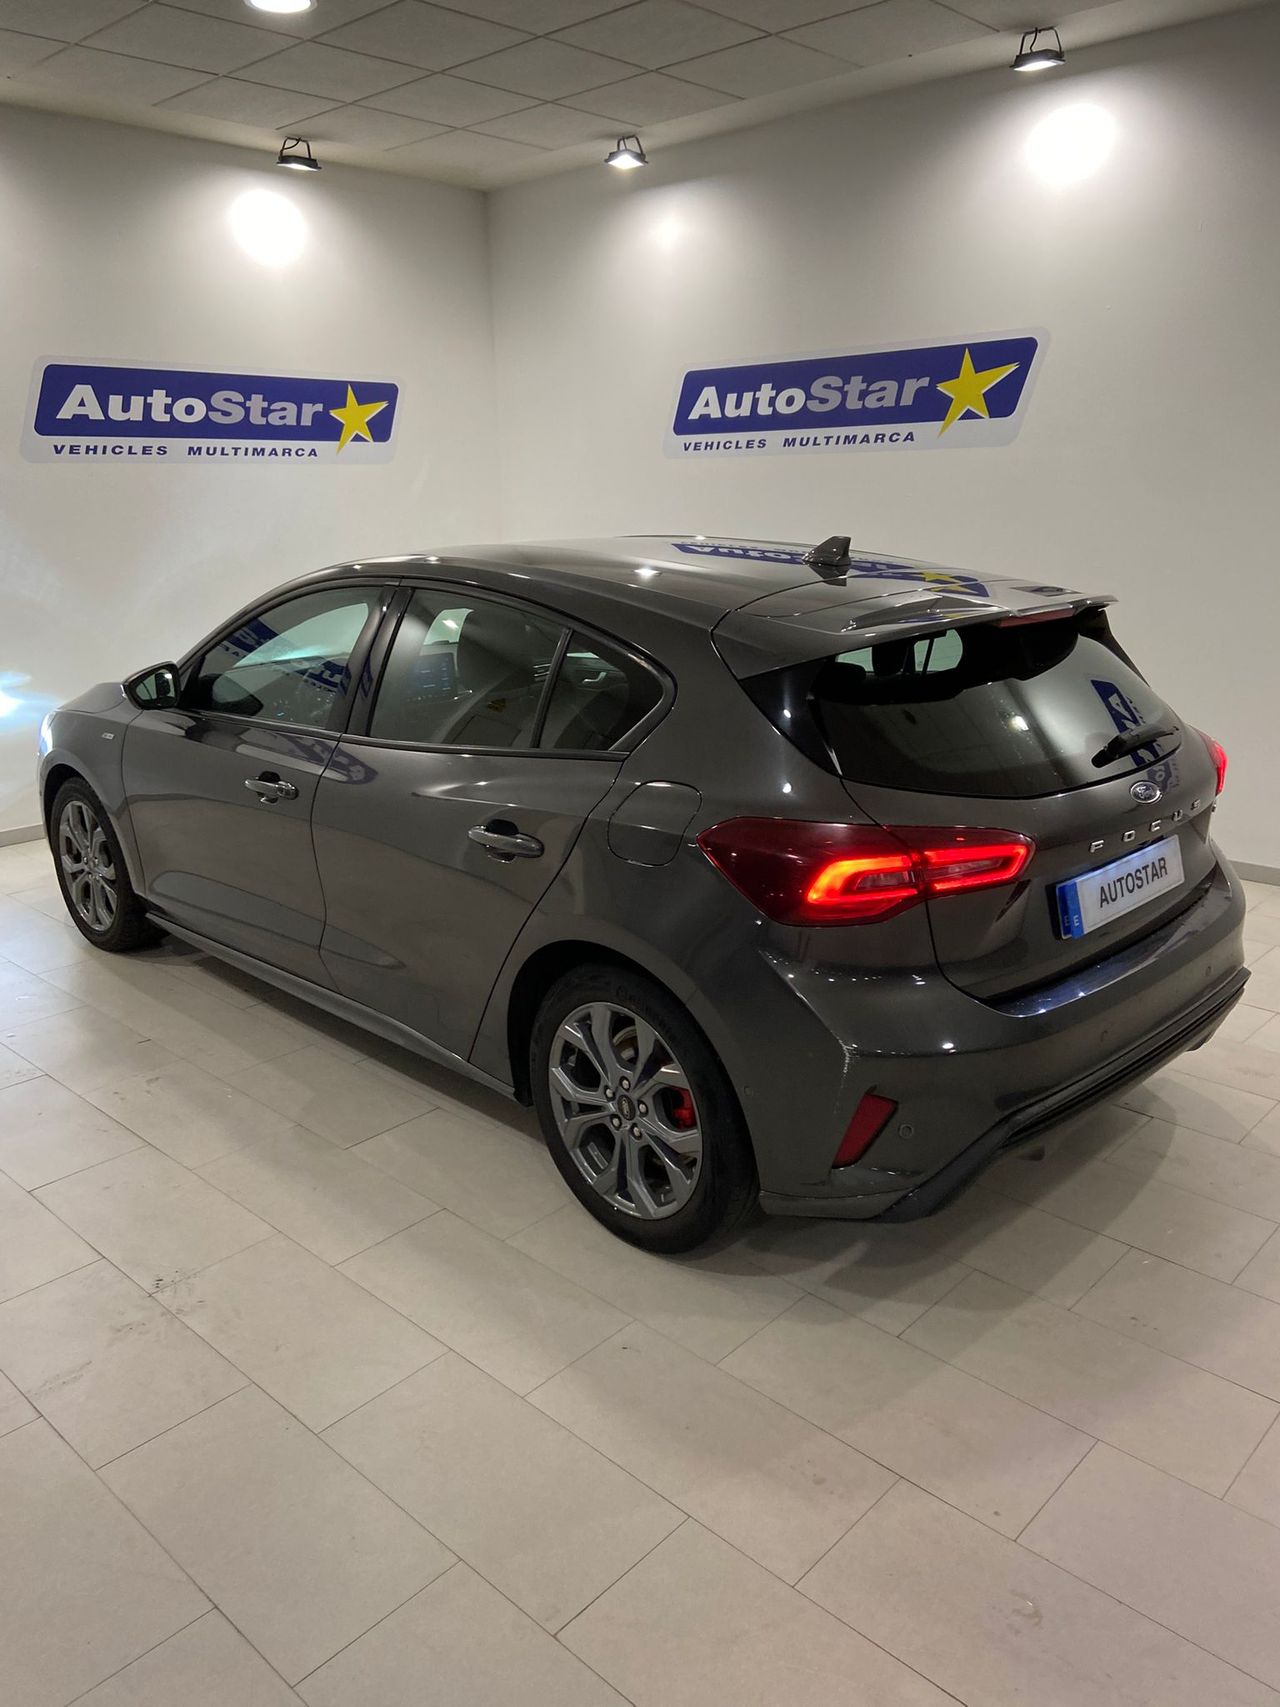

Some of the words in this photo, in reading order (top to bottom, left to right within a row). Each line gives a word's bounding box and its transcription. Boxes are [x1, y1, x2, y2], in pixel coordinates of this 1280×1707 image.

[55, 384, 324, 427] AutoStar
[687, 375, 930, 420] AutoStar
[52, 444, 169, 456] VEHICLES
[187, 446, 319, 458] MULTIMARCA
[683, 439, 767, 452] VEHICLES
[782, 431, 916, 448] MULTIMARCA
[1089, 799, 1201, 853] FOCUS
[1099, 856, 1168, 908] AUTOSTAR
[1073, 914, 1080, 927] E
